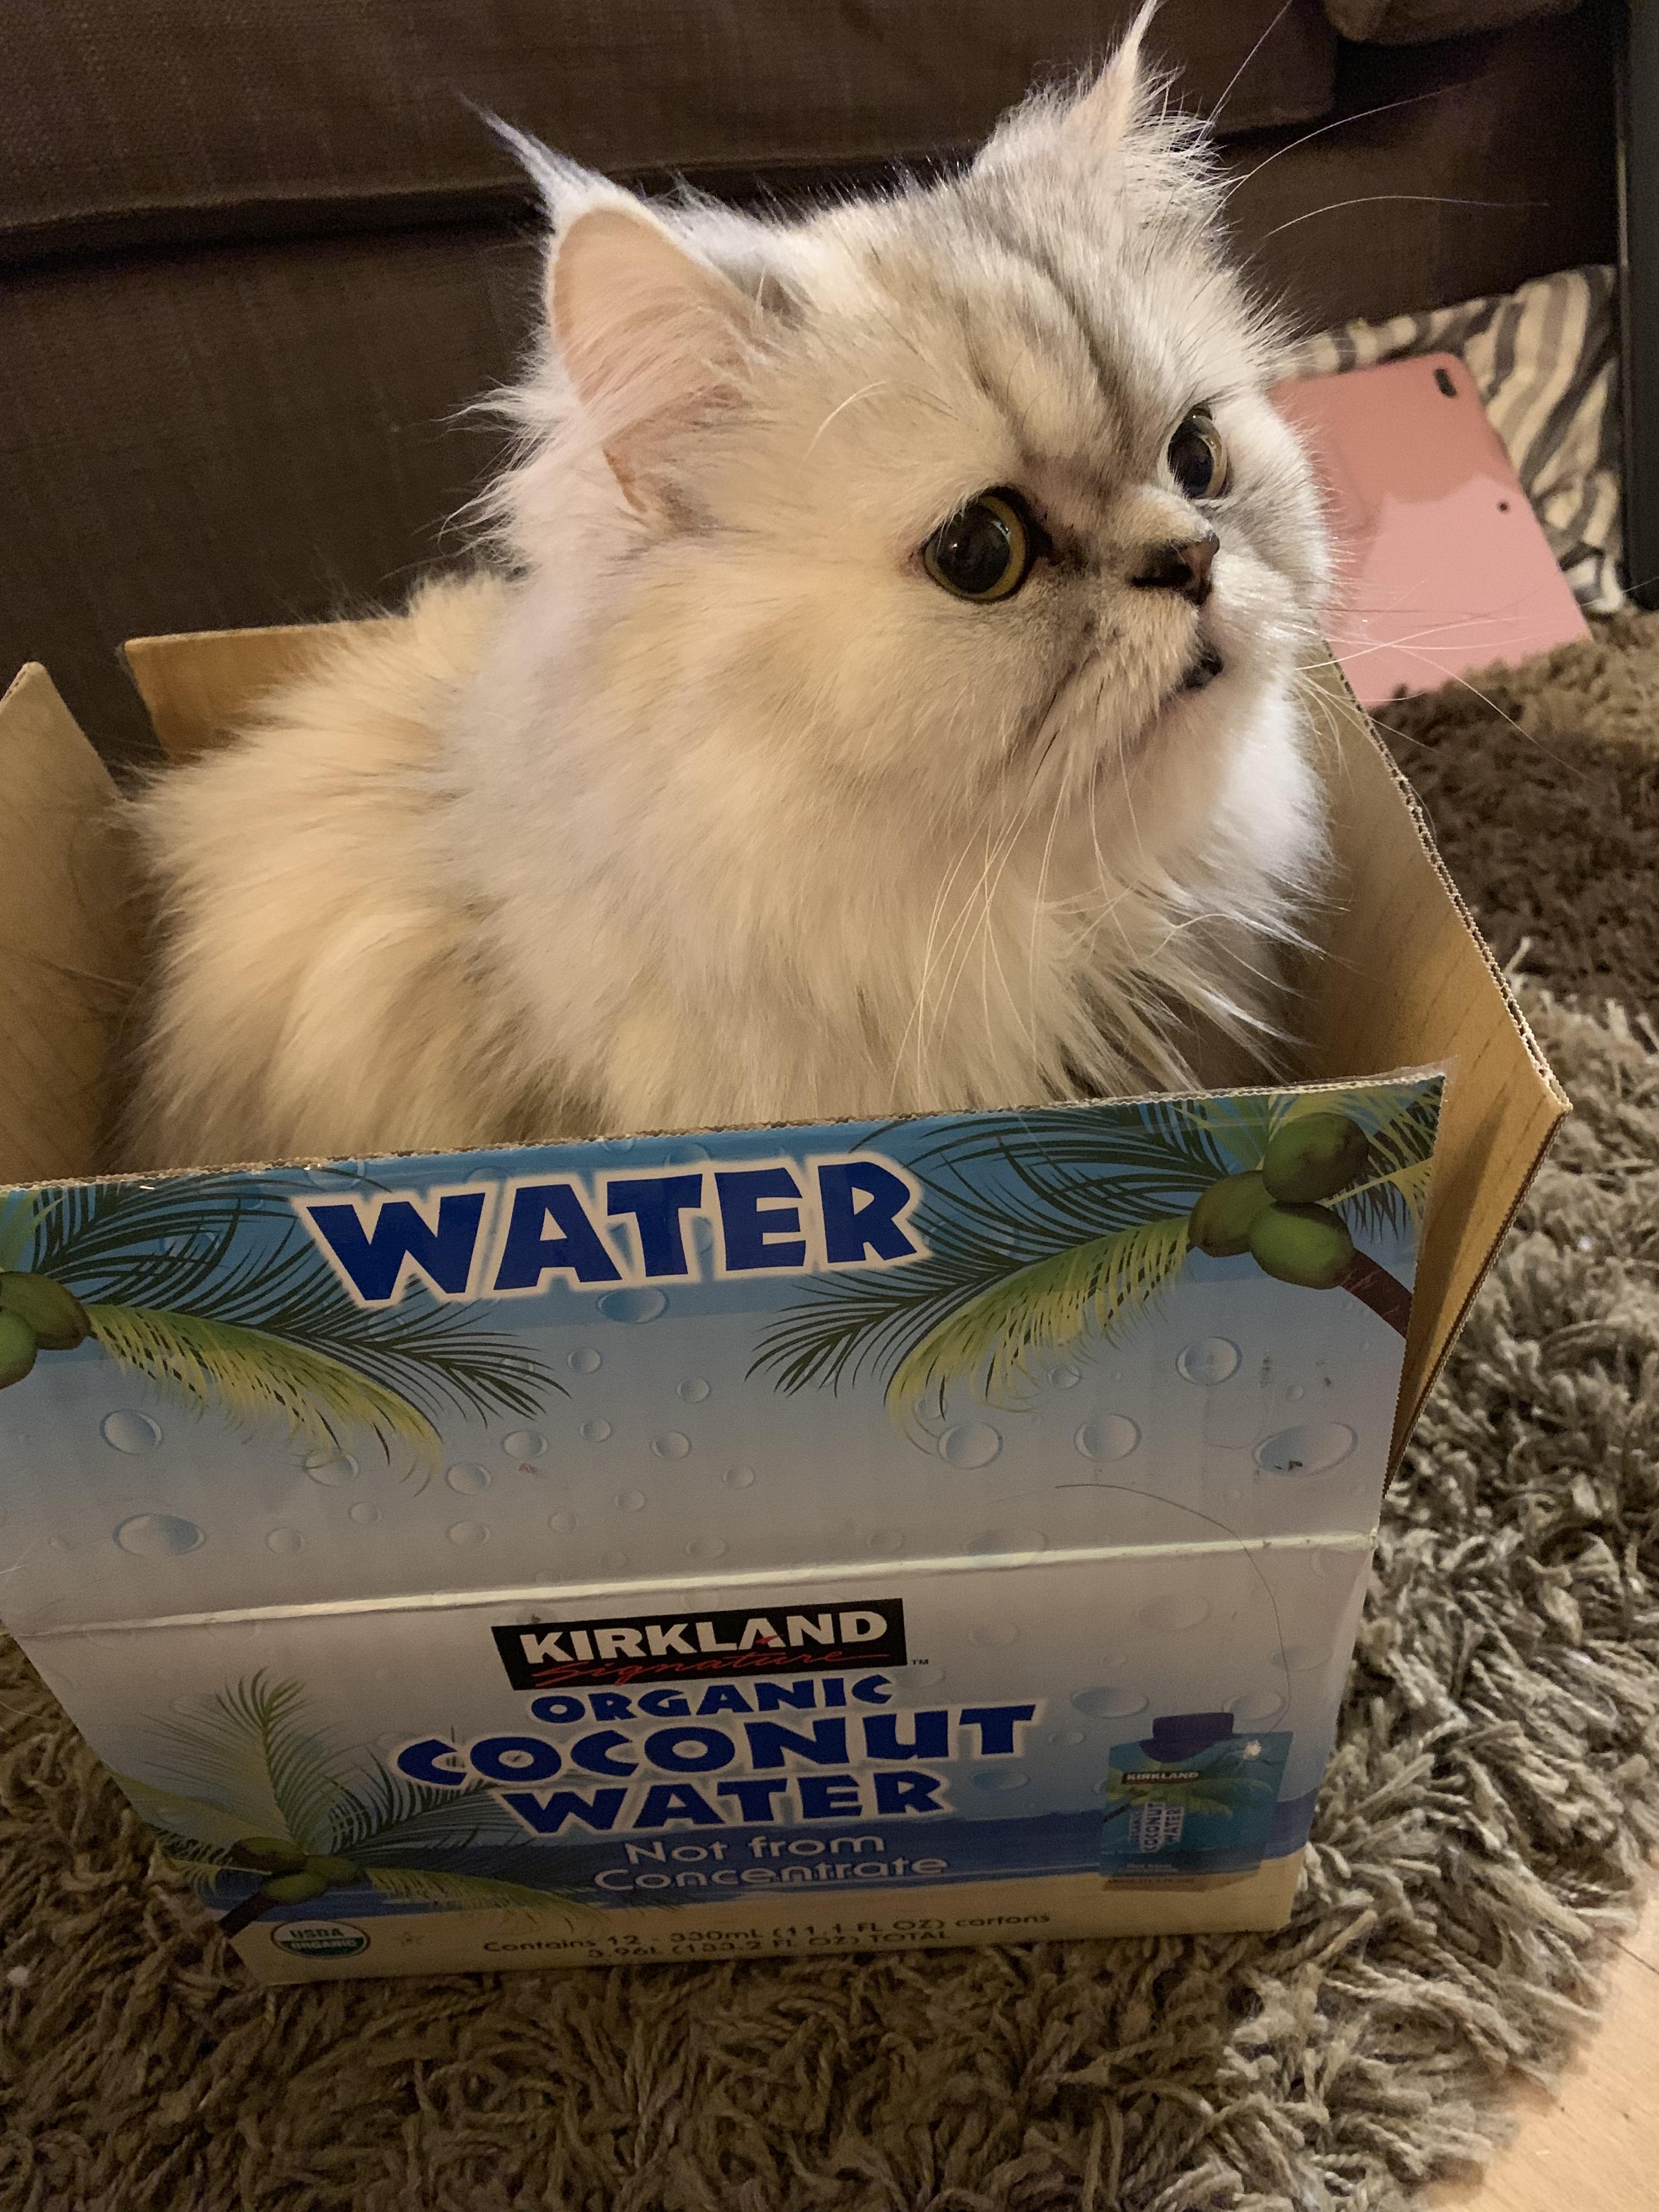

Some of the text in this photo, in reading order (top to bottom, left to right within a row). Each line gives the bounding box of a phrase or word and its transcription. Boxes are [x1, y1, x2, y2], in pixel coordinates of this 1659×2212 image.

[307, 1161, 917, 1301] WATER
[520, 1610, 887, 1664] KIRKLAND
[531, 1649, 889, 1688] Signature
[531, 1674, 894, 1724] ORGANIC
[398, 1703, 1035, 1786] COCONUT
[1126, 1771, 1200, 1781] KIRKLAND
[504, 1770, 950, 1833] WATER
[1144, 1802, 1163, 1851] COCONUT
[1165, 1808, 1182, 1843] WATER
[625, 1831, 884, 1865] Not from
[594, 1854, 948, 1892] Concentrate
[289, 1928, 345, 1938] USDA
[484, 1940, 596, 1952] Contains
[608, 1935, 640, 1945] 12
[857, 1922, 882, 1932] FL
[955, 1914, 1050, 1927] cartons
[870, 1931, 949, 1943] TOTAL
